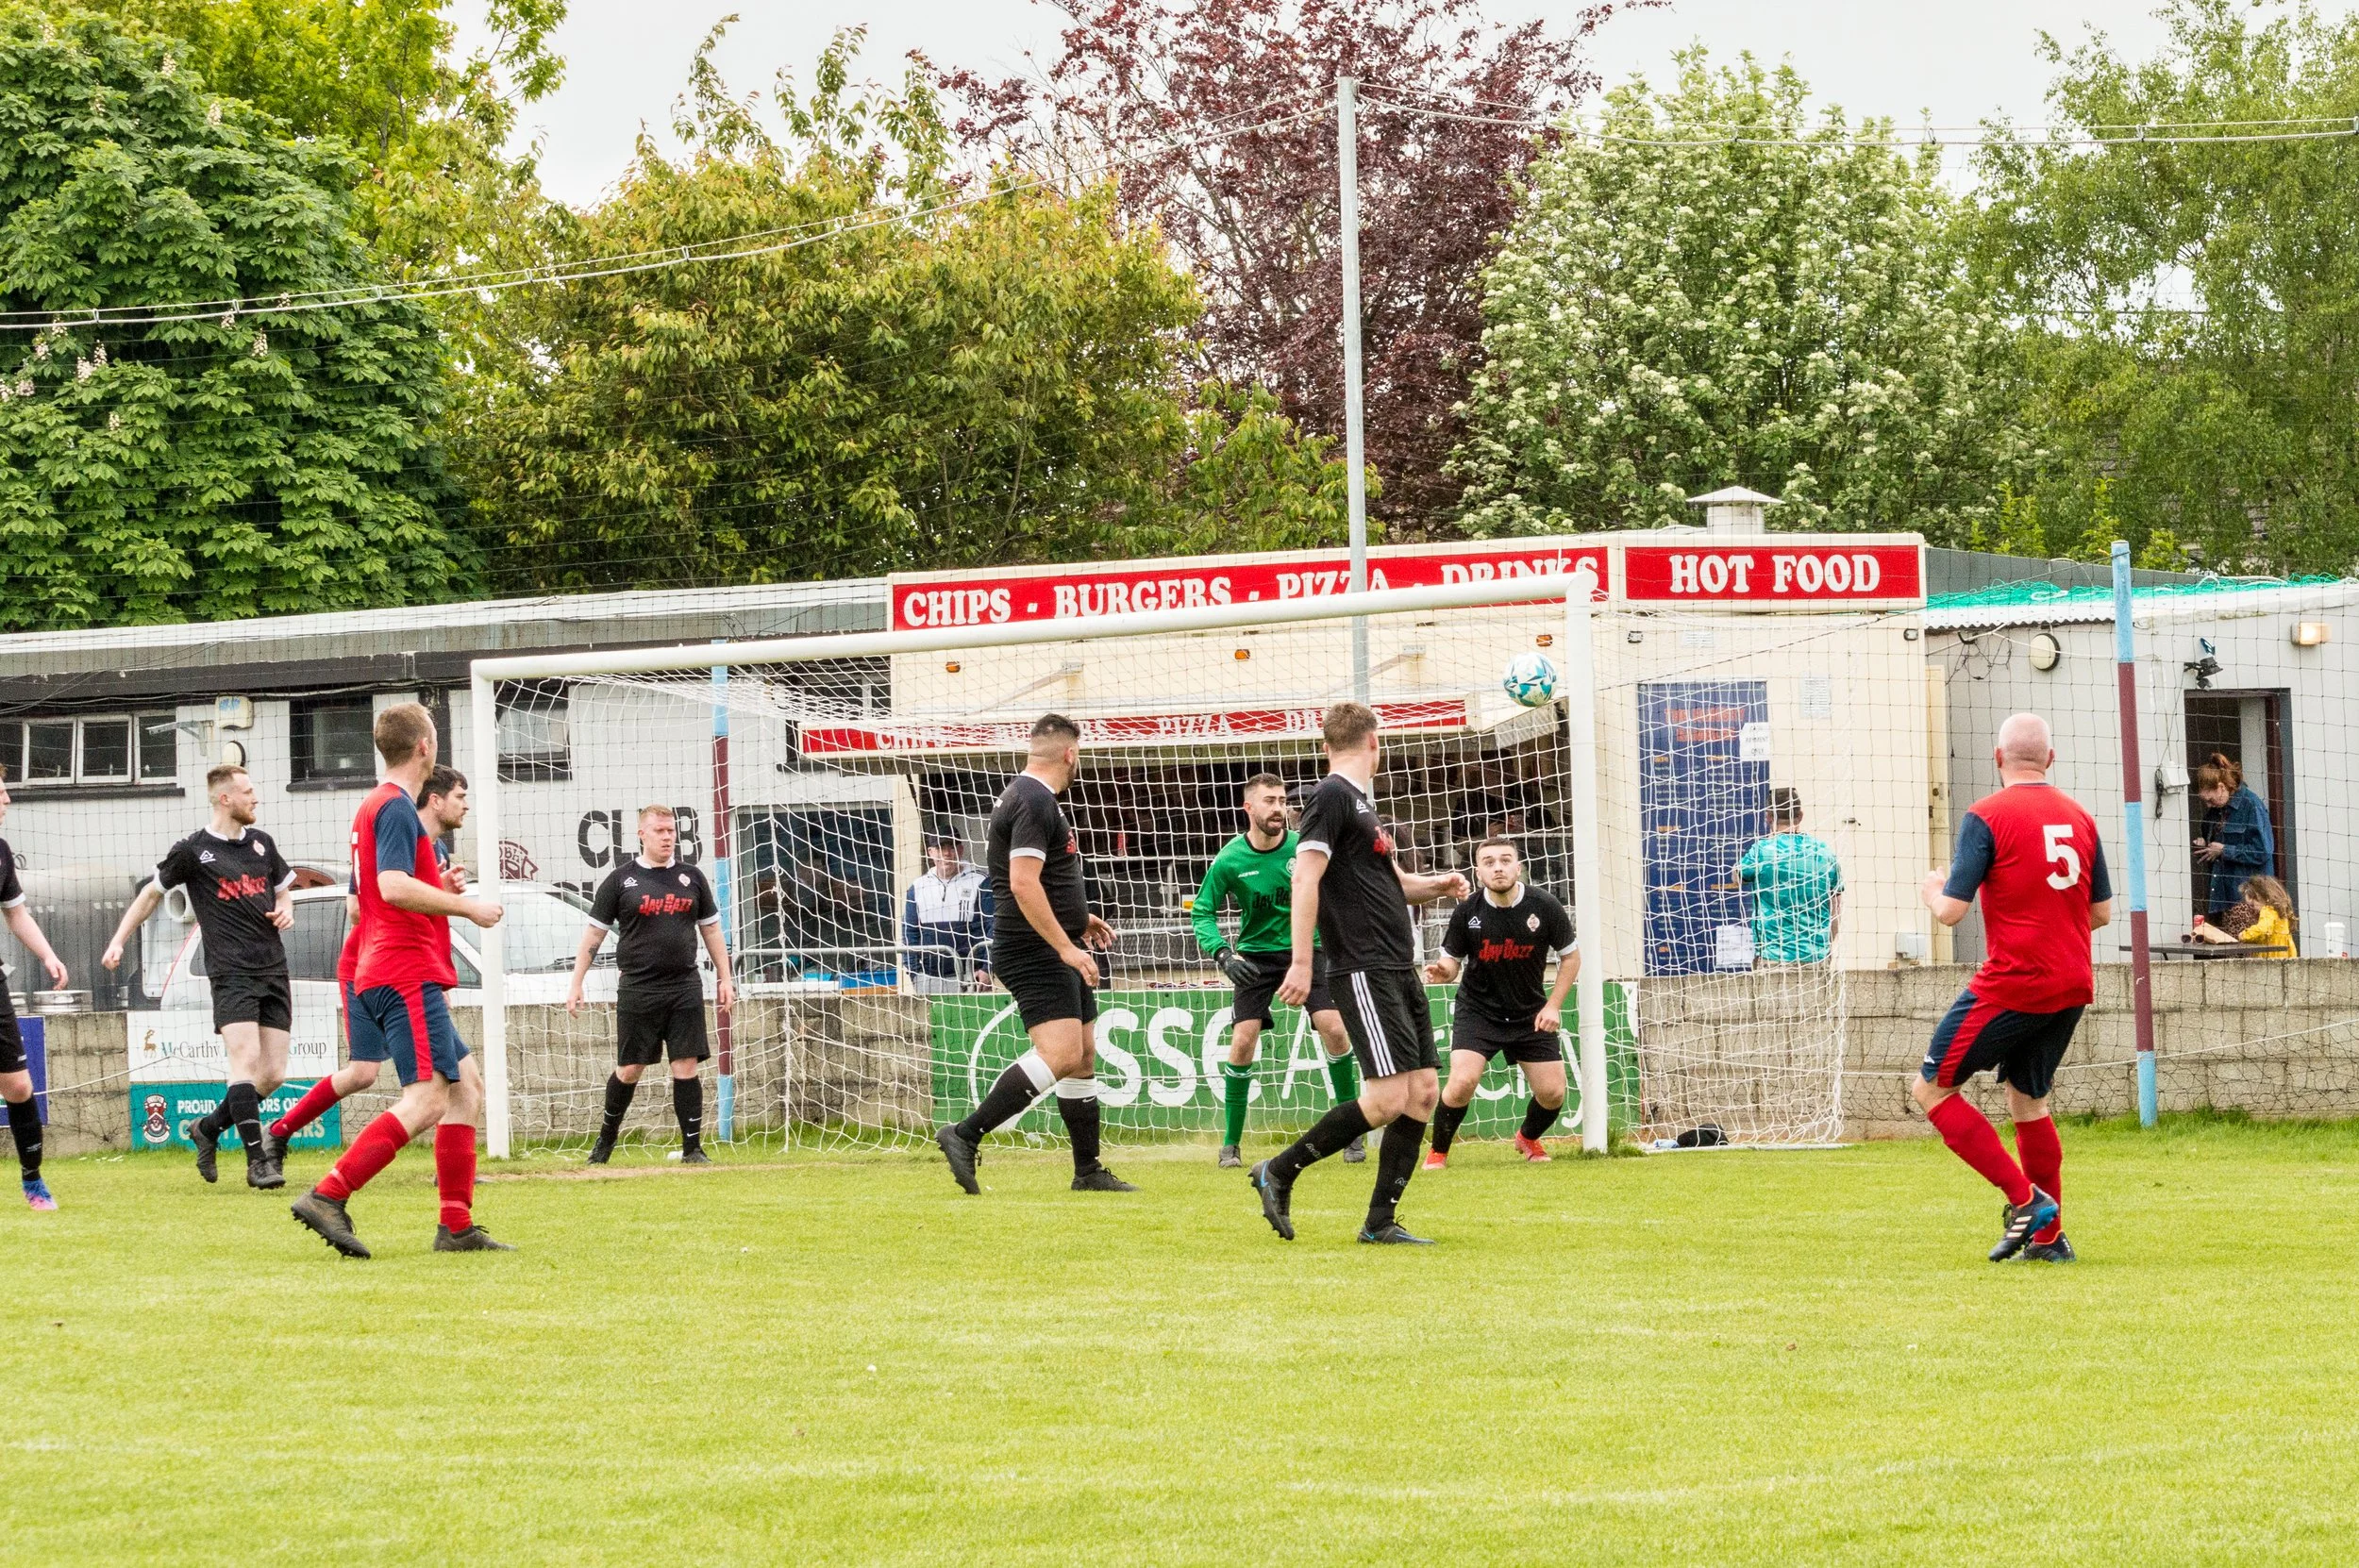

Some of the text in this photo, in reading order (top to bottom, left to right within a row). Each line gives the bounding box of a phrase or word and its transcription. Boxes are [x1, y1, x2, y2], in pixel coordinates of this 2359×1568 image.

[1669, 554, 1881, 593] HOT FOOD
[904, 587, 1012, 627] CHIPS
[1054, 576, 1232, 619] BURGERS
[577, 807, 703, 868] CLB
[2042, 824, 2081, 891] 5
[161, 1041, 220, 1059] McCarthy
[290, 1042, 326, 1059] Group
[177, 1099, 217, 1114] PROUD
